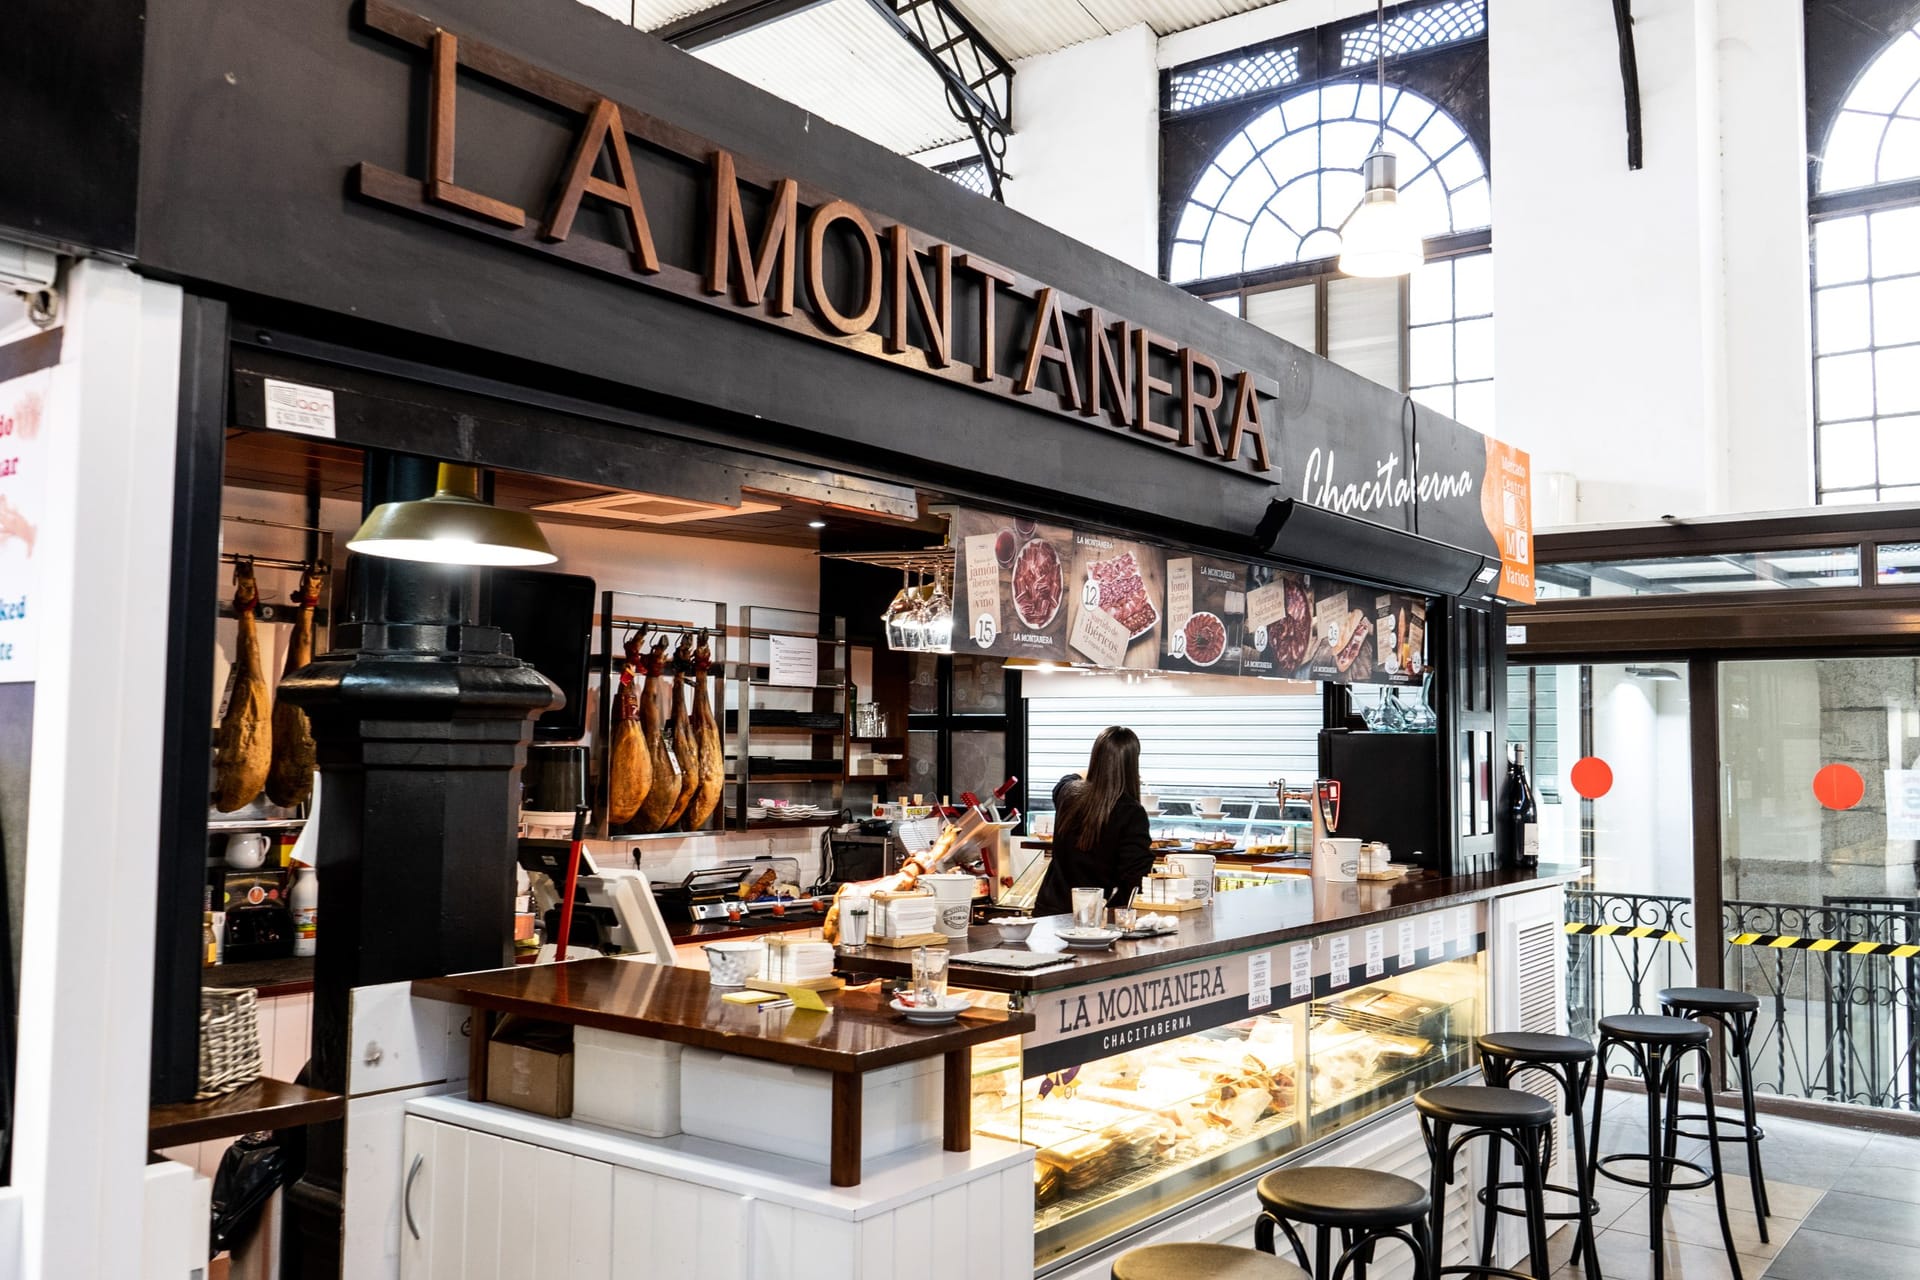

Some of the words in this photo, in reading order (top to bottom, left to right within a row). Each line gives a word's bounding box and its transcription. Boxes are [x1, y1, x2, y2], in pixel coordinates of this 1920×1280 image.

[430, 28, 661, 275] LA
[706, 150, 1272, 472] MONTANERA
[1302, 442, 1473, 514] Chacitaberna
[1502, 455, 1526, 479] Mercado
[1502, 475, 1527, 497] Central
[1076, 536, 1084, 545] LA
[968, 563, 997, 581] jamón
[1200, 566, 1208, 575] LA
[1505, 565, 1530, 587] Varios
[1171, 581, 1189, 593] lomo
[975, 596, 994, 609] vino
[1012, 632, 1021, 642] LA
[1021, 634, 1053, 645] MONTANERA
[1085, 619, 1118, 654] ibéricos
[1059, 995, 1091, 1034] LA
[1097, 966, 1226, 1025] MONTANERA
[1103, 1015, 1192, 1050] CHACITABERNA
